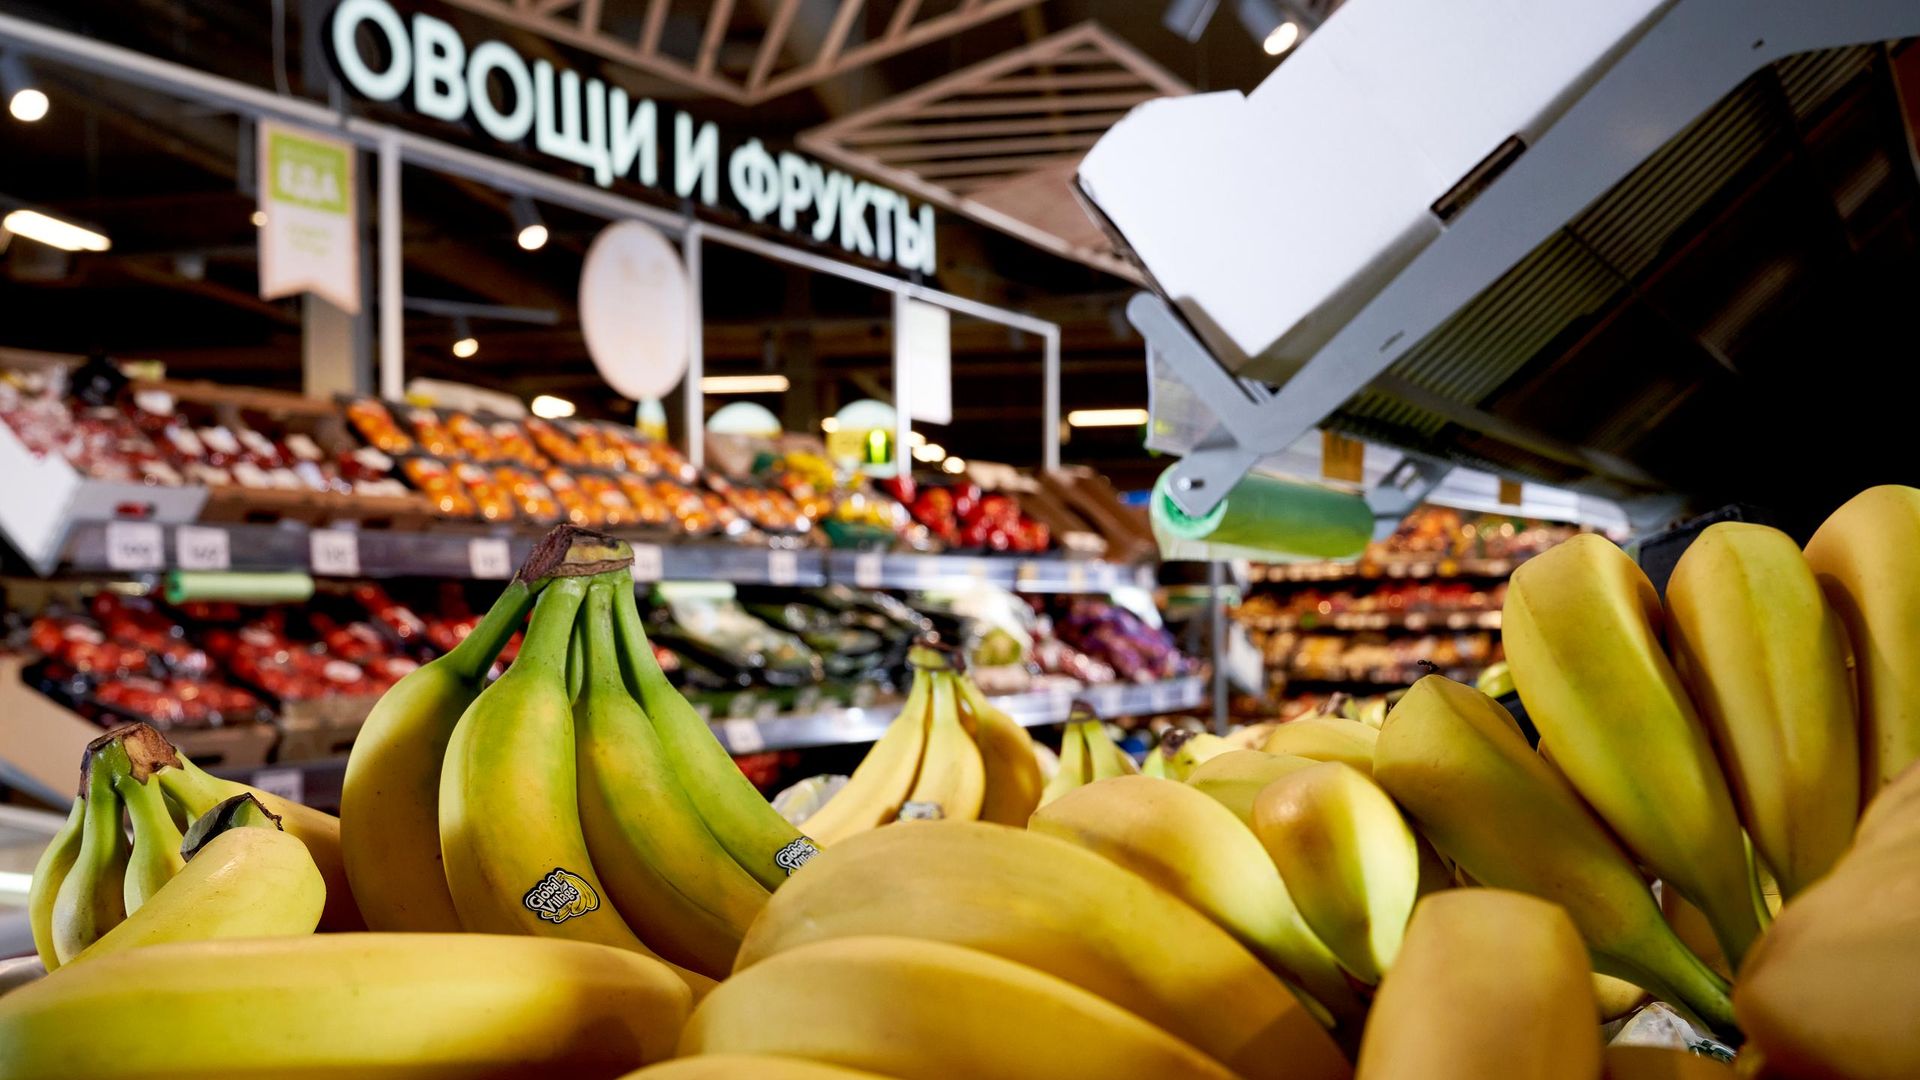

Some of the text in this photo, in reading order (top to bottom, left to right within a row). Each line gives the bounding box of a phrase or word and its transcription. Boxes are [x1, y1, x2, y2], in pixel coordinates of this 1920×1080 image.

[332, 0, 936, 276] ОВОЩИ И ФРУКТЫ
[779, 841, 807, 865] Global
[529, 878, 561, 908] Global
[540, 886, 578, 913] Village
